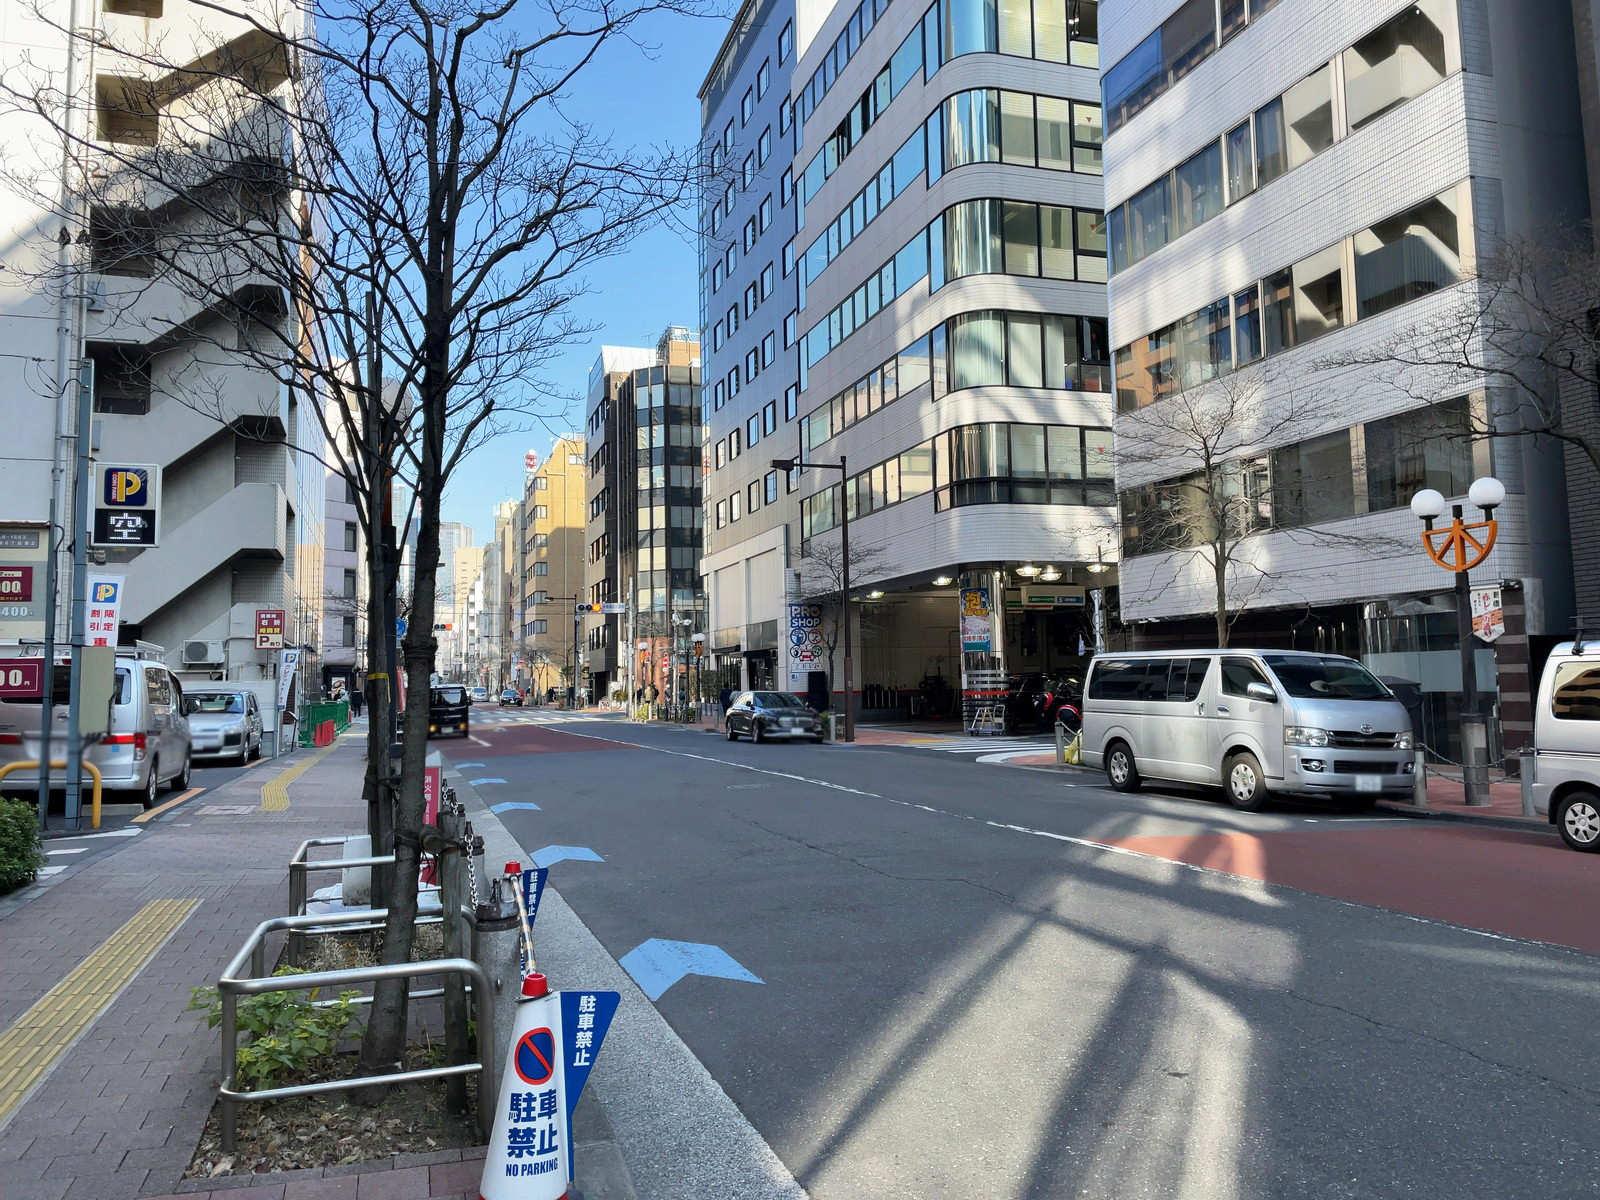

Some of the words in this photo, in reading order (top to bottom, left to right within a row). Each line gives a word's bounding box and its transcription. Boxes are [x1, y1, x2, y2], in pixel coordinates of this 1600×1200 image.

[109, 512, 142, 540] 空
[90, 609, 101, 632] 割引
[103, 609, 115, 632] 限定
[791, 606, 821, 617] PRO
[791, 618, 821, 627] SHOP
[259, 635, 270, 646] P
[527, 871, 539, 917] 駐車禁止
[573, 994, 597, 1067] 駐車禁止
[508, 1088, 557, 1123] 駐車
[507, 1123, 559, 1159] 禁止
[505, 1163, 519, 1177] NO
[521, 1158, 559, 1177] PARKING
